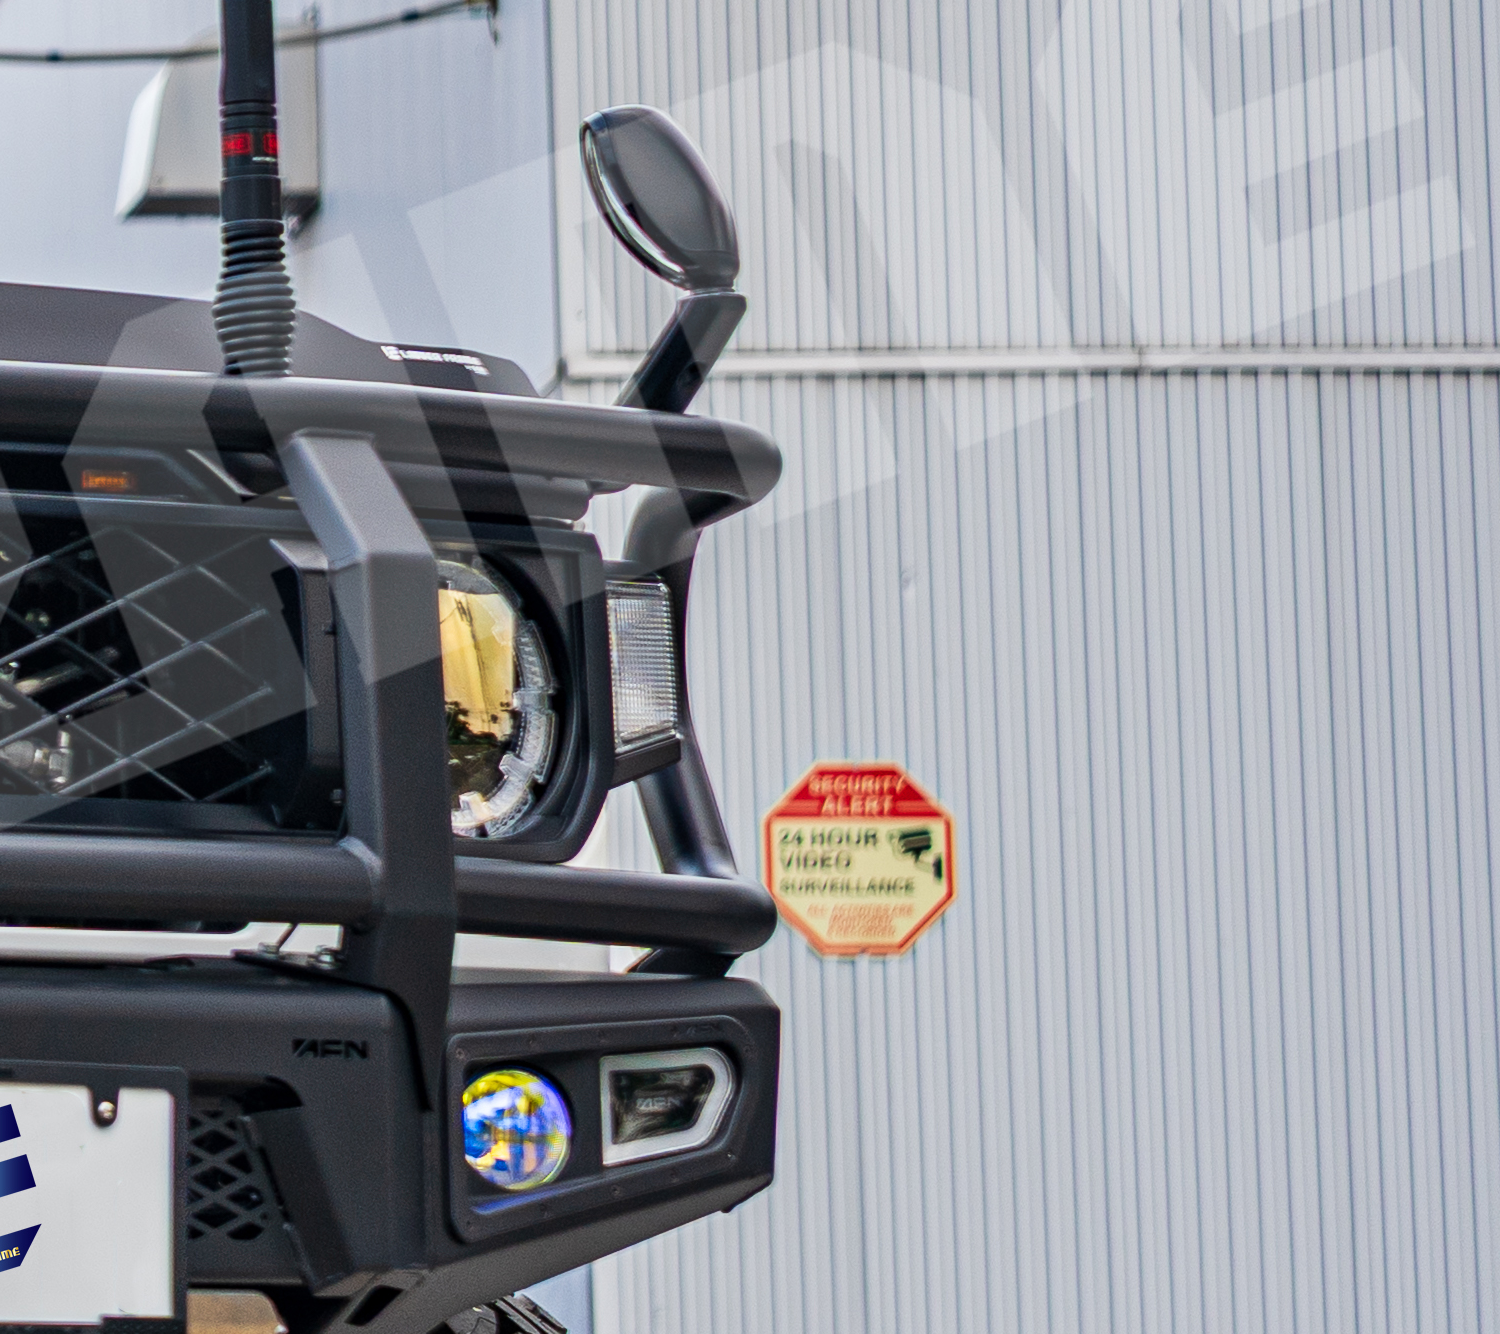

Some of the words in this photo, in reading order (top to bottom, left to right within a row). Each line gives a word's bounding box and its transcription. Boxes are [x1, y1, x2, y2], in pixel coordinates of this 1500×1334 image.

[807, 774, 908, 796] SECURITY
[820, 795, 894, 816] ALERT
[778, 827, 804, 846] 24
[810, 827, 878, 847] HOUR
[779, 850, 852, 873] VIDEO
[778, 877, 916, 898] SURVEILLANCE
